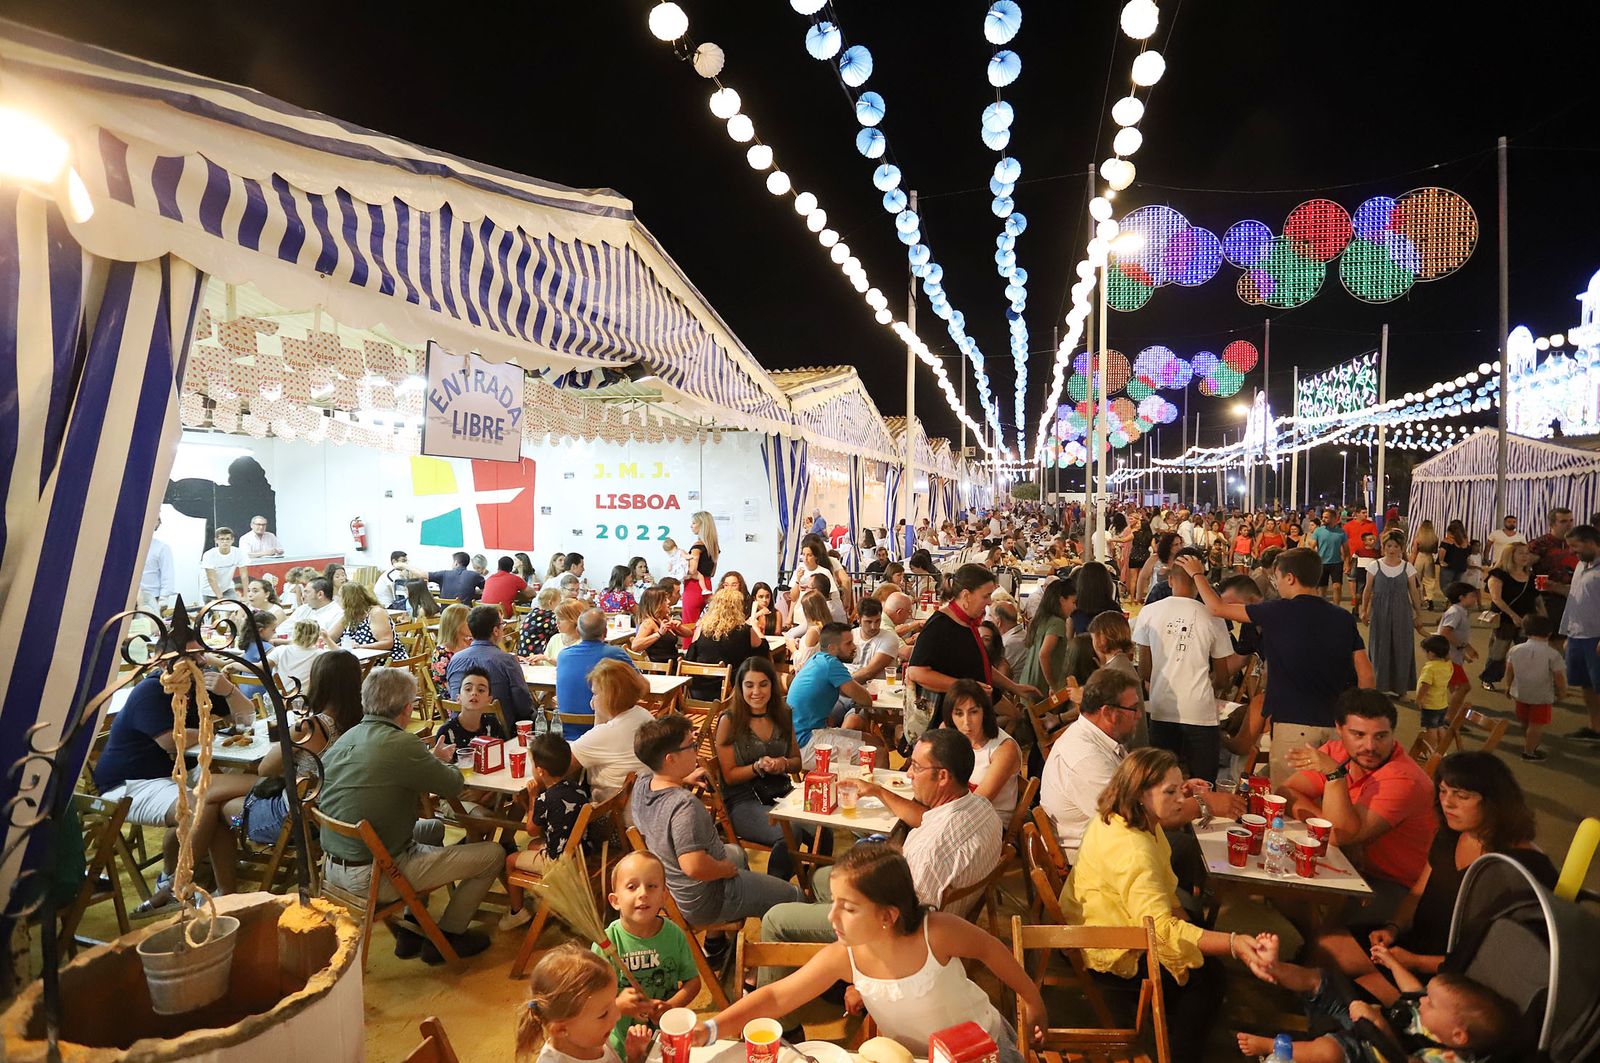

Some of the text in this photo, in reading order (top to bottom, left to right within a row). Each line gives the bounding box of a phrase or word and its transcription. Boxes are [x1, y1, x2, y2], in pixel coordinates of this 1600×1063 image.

[289, 359, 310, 368] Solear
[313, 351, 337, 361] Solear
[429, 368, 522, 428] ENTRADA
[452, 410, 505, 441] LIBRE
[595, 494, 681, 510] LISBOA
[620, 953, 661, 971] HULK
